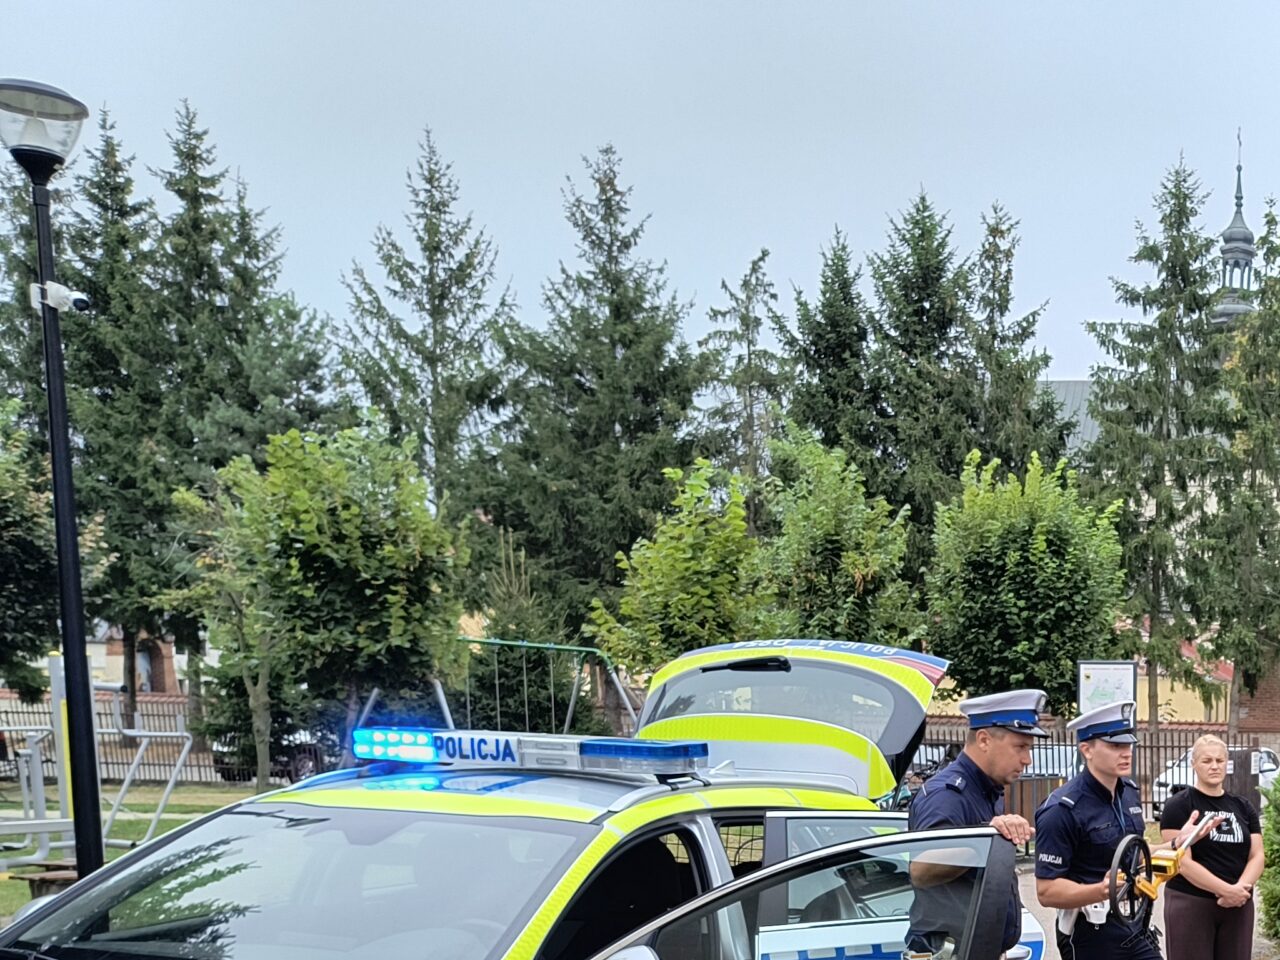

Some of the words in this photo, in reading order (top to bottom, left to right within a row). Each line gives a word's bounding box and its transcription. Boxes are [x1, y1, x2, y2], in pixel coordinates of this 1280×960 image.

[817, 639, 899, 655] POLICJA
[434, 735, 516, 762] POLICJA
[1039, 853, 1063, 865] POLICJA
